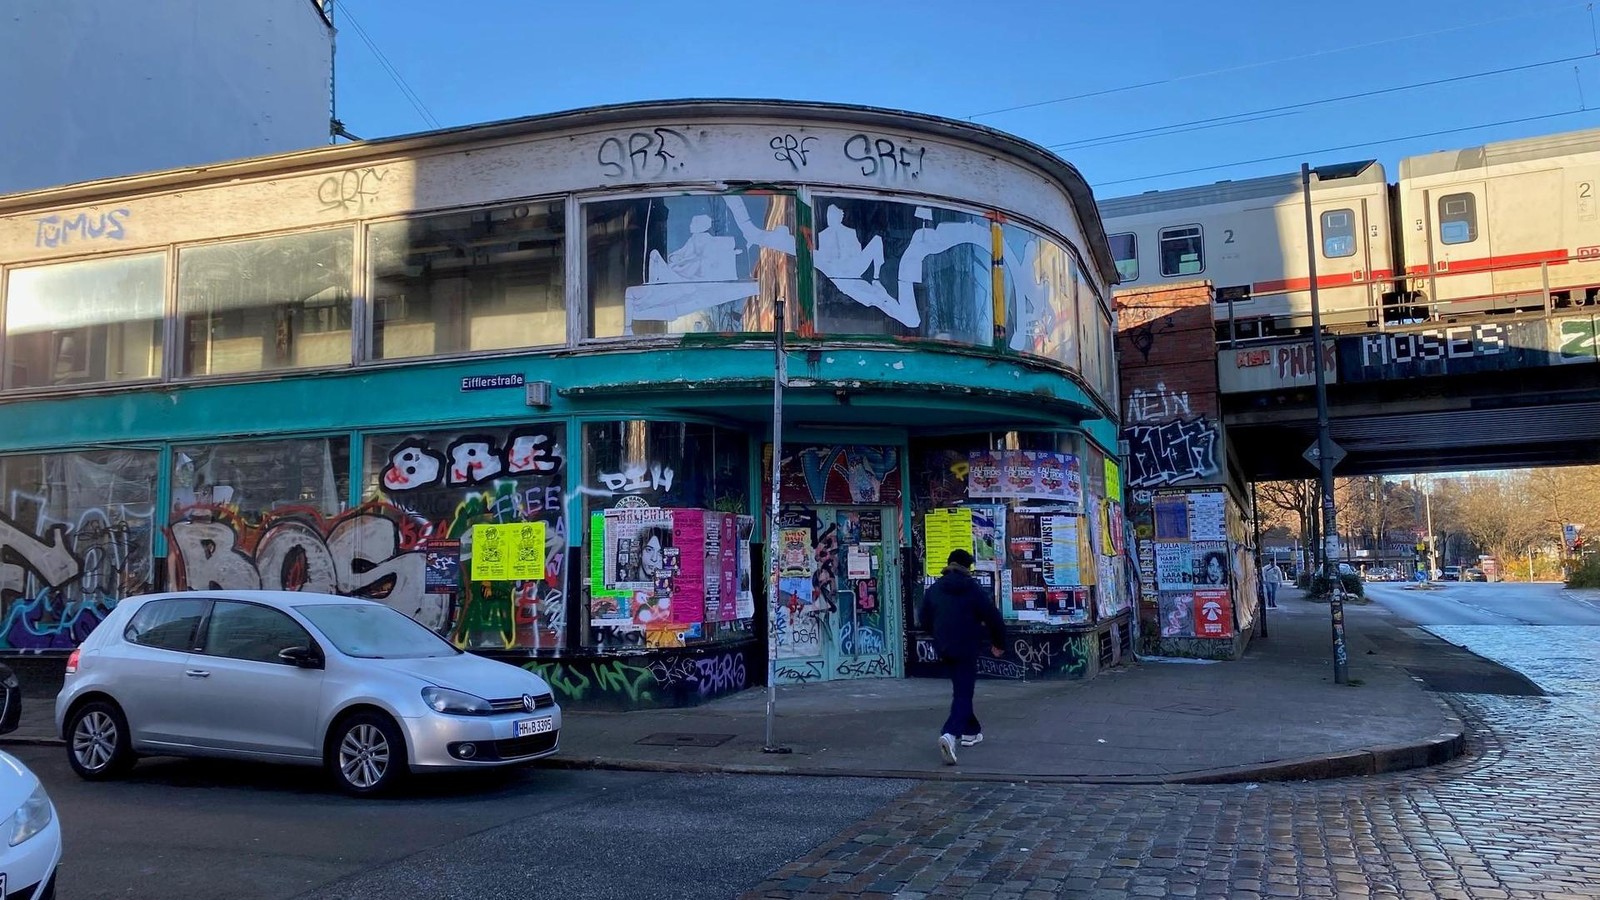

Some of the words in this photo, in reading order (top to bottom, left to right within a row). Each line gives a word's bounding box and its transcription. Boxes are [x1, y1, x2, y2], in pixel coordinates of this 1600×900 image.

[1579, 182, 1591, 199] 2
[1223, 229, 1235, 244] 2
[1362, 324, 1504, 367] MOSES
[462, 375, 523, 389] Eifflerstraße
[1128, 382, 1191, 421] NEIN
[493, 486, 562, 522] FREE
[519, 722, 528, 735] HH
[536, 719, 552, 732] 3395
